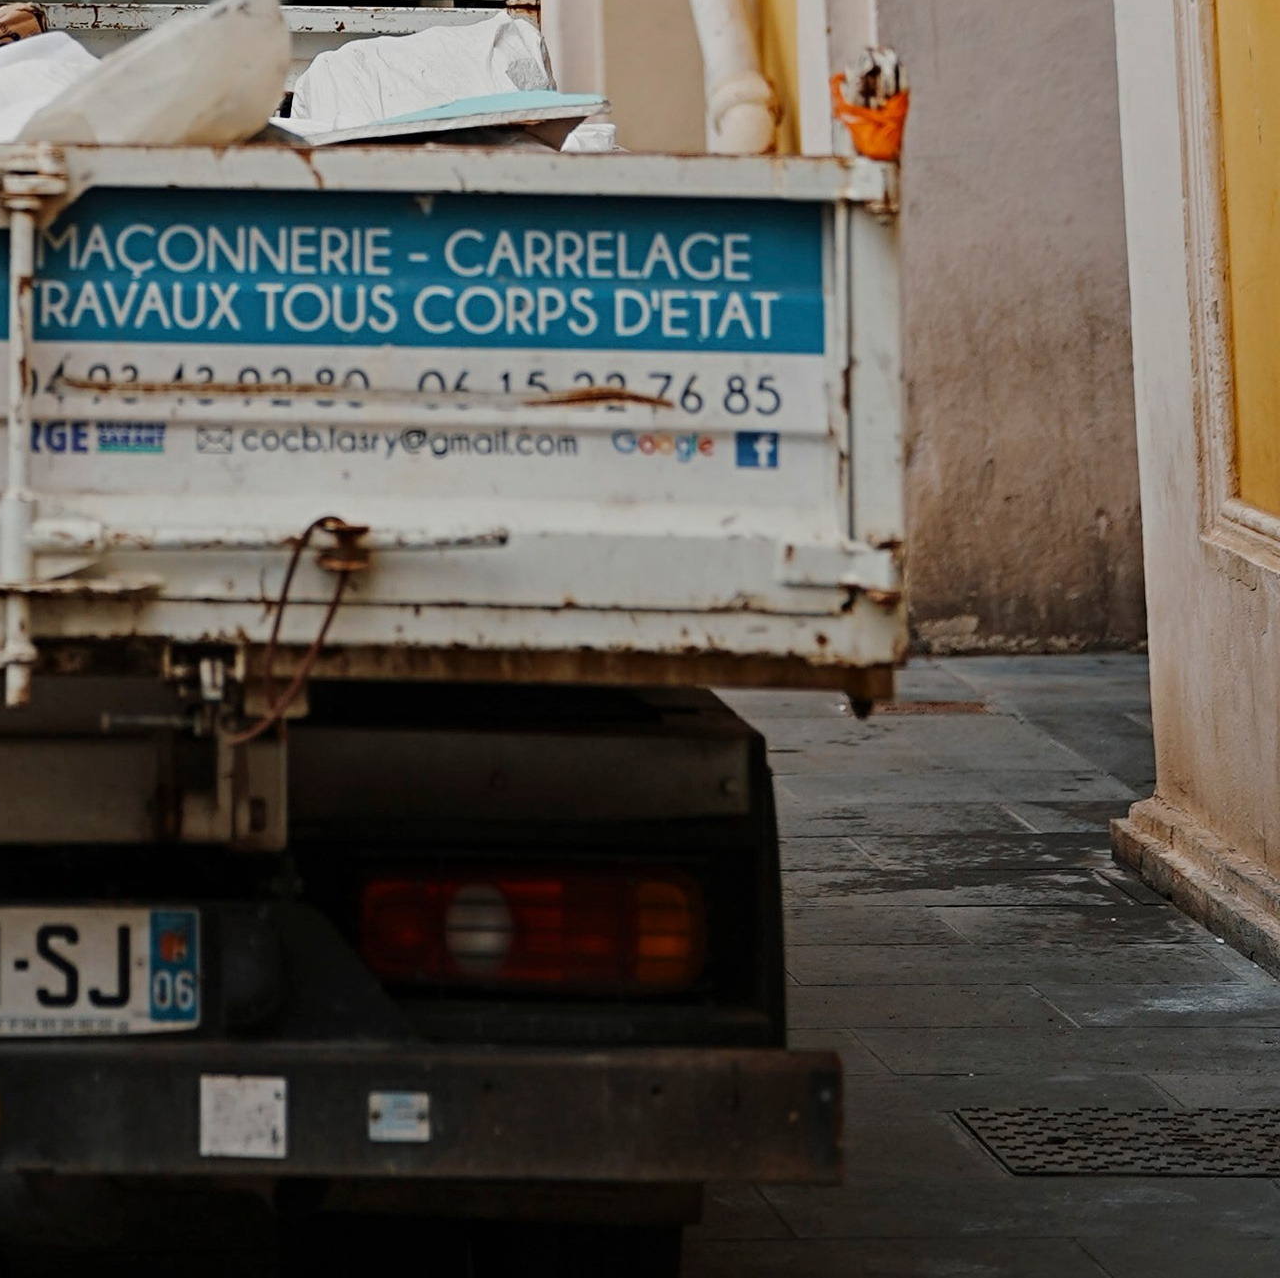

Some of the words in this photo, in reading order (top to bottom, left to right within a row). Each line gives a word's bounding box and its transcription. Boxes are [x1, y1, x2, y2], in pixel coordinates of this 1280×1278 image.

[35, 223, 392, 278] MAÇONNERIE
[444, 228, 753, 281] CARRELAGE
[255, 282, 399, 333] TOUS
[413, 285, 599, 336] CORPS
[614, 287, 781, 338] D'ETAT
[723, 374, 783, 416] 85
[612, 428, 715, 462] Google
[153, 969, 194, 1012] 06
